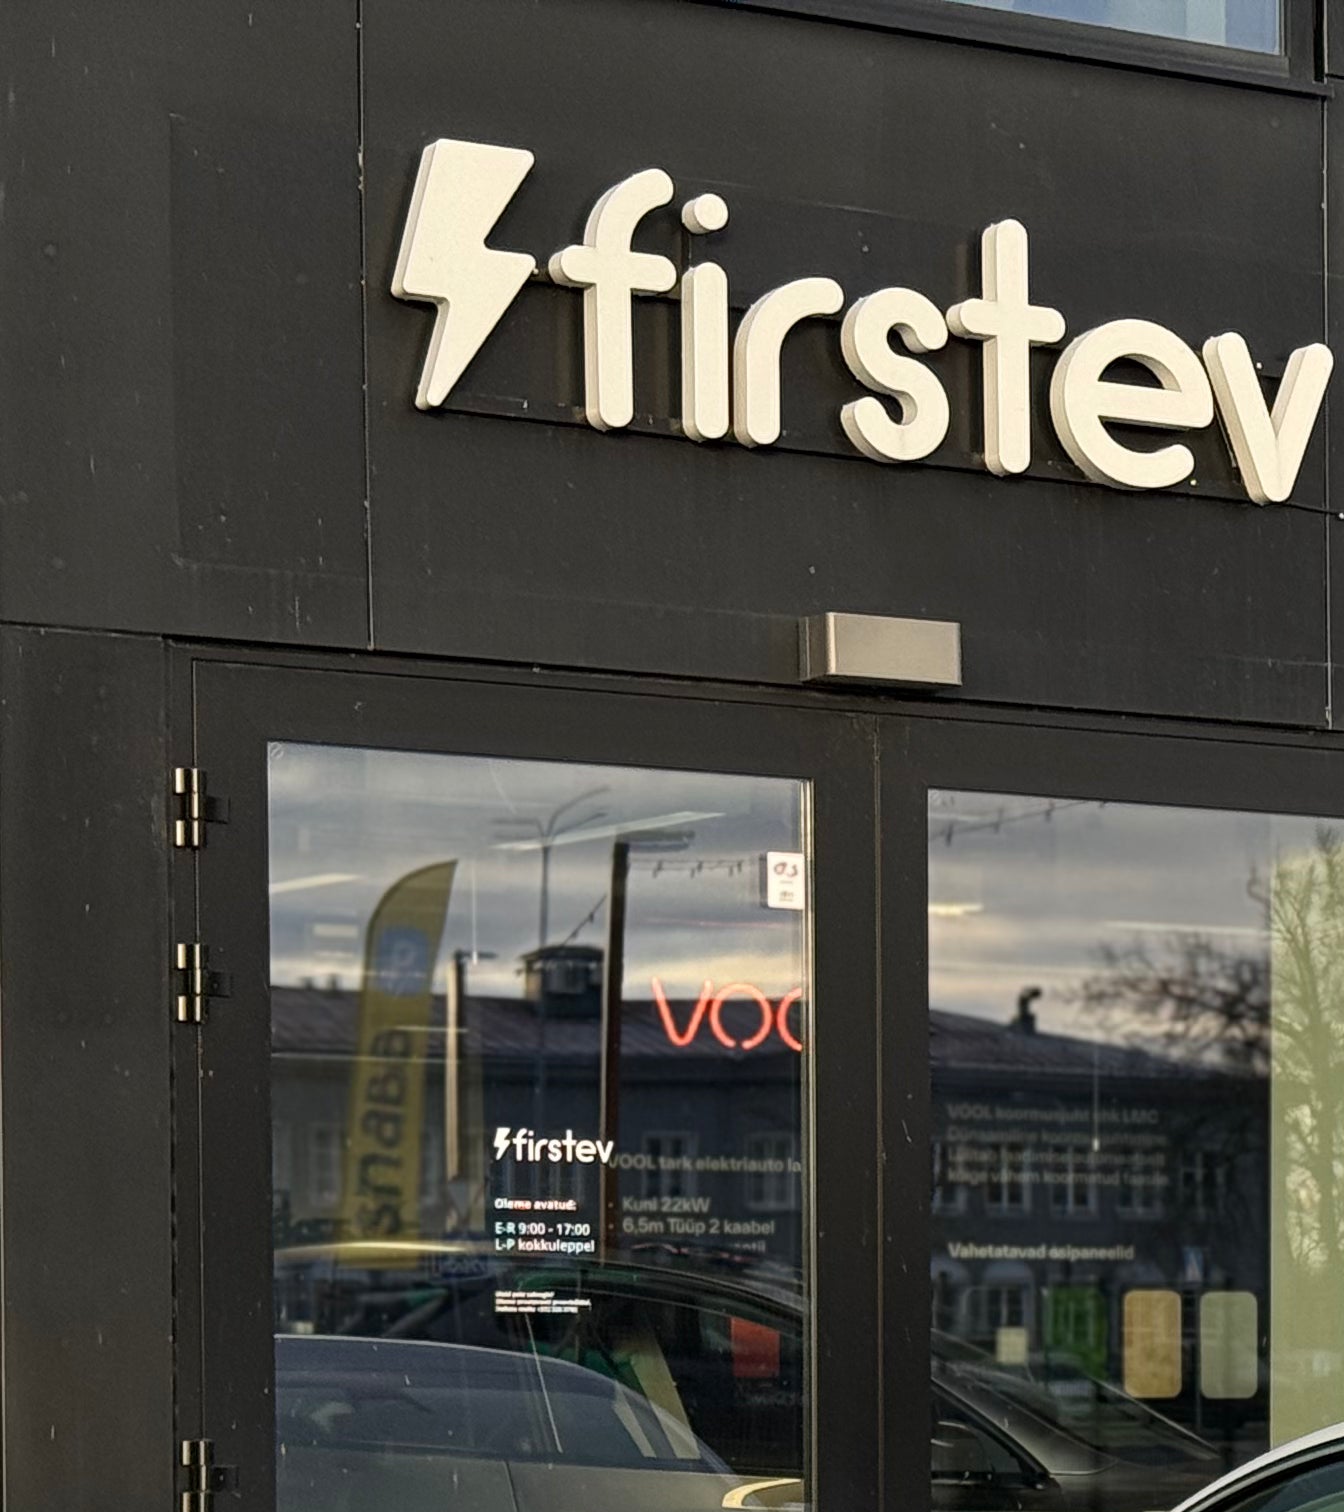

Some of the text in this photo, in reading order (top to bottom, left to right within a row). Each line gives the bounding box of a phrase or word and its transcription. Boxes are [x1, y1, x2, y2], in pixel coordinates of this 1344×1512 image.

[547, 167, 1334, 505] firstev
[512, 1128, 614, 1164] firstev
[659, 1157, 693, 1171] tark
[696, 1158, 784, 1173] elektriauto
[494, 1198, 532, 1211] Oleme
[622, 1197, 711, 1213] Kuni 22kW
[494, 1221, 516, 1235] E-R
[518, 1222, 547, 1236] 9:00
[556, 1223, 591, 1237] 17:00
[622, 1217, 777, 1238] 6,5m Tüüp 2 kaabel
[494, 1238, 596, 1256] L-P kokkuleppel
[947, 1242, 1047, 1260] Vahetatavad
